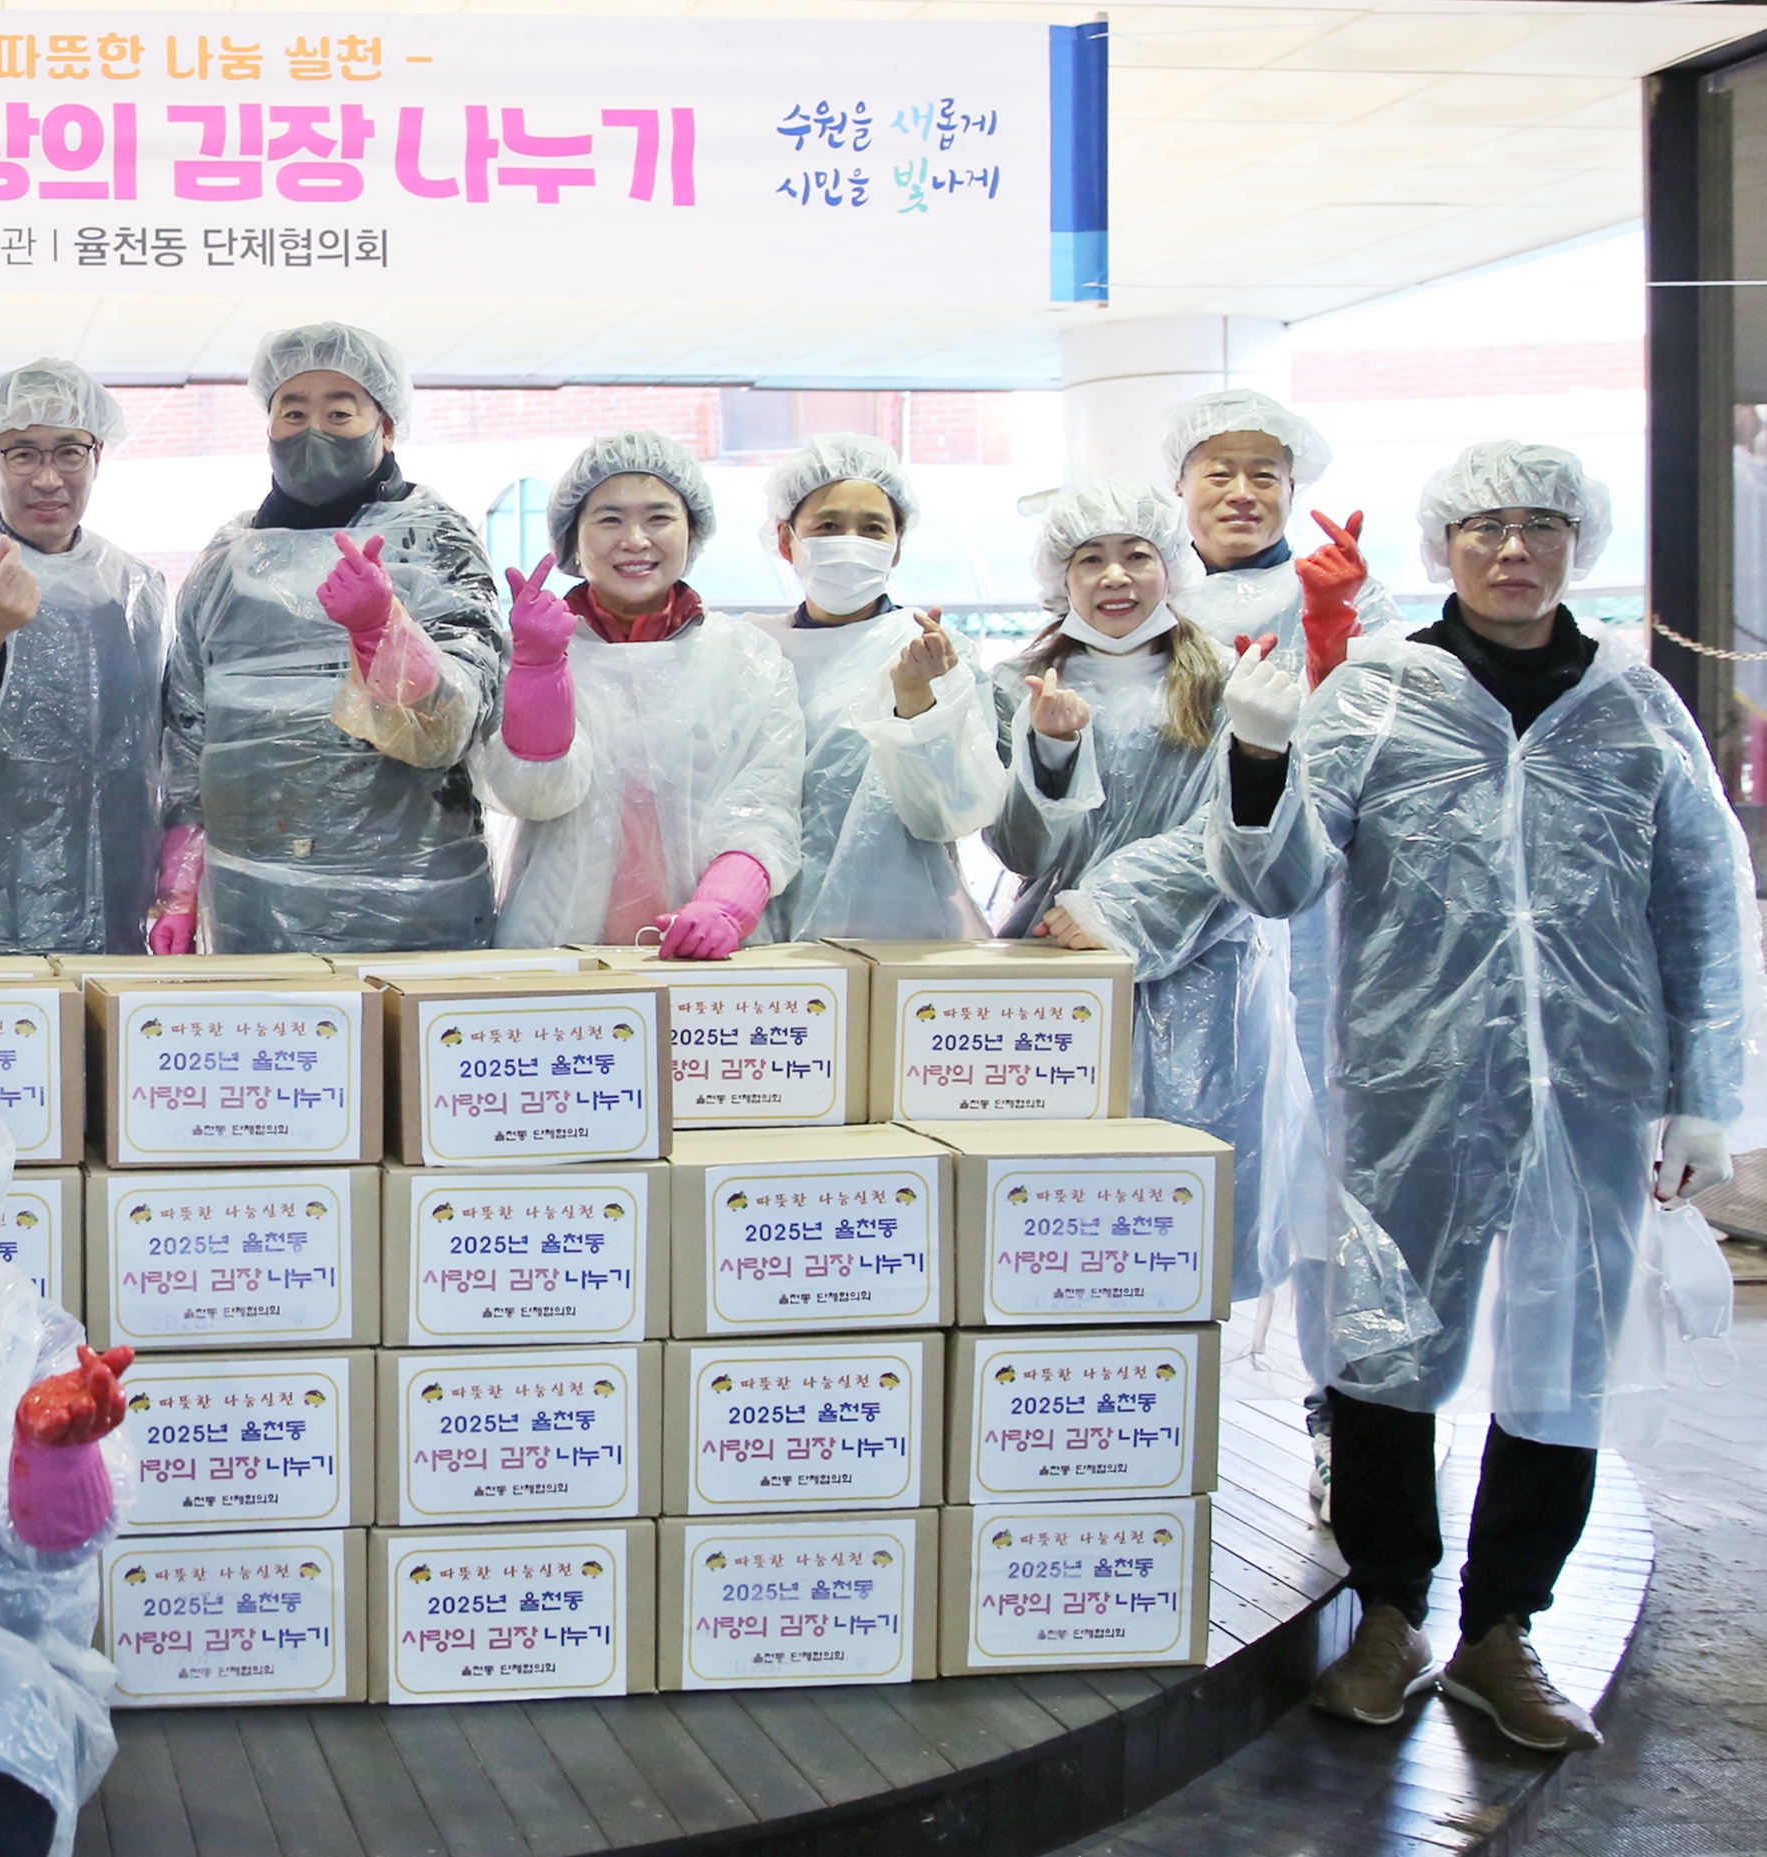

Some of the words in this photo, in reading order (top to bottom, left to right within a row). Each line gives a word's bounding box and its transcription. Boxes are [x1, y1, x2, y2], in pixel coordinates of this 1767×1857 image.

[166, 35, 264, 81] 나눔
[285, 35, 382, 82] 실천
[776, 100, 874, 152] 수원을
[888, 97, 998, 151] 새롭게
[166, 103, 376, 203] 김장
[394, 105, 696, 207] 나누기
[775, 167, 871, 208] 시민을
[891, 156, 1000, 215] 빛나게
[73, 226, 187, 268] 율천동
[203, 227, 388, 268] 단체협의회
[943, 1007, 990, 1020] 따뜻한
[470, 1029, 522, 1044] 따뜻한
[670, 1028, 739, 1046] 2025년
[750, 1026, 808, 1046] 율천동
[932, 1034, 1003, 1052] 2025년
[1015, 1032, 1073, 1052] 율천동
[159, 1052, 239, 1072] 2025년
[252, 1050, 318, 1072] 율천동
[460, 1057, 539, 1078] 2025년
[551, 1054, 615, 1076] 율천동
[721, 1059, 767, 1081] 김장
[771, 1060, 831, 1079] 나누기
[907, 1064, 973, 1086] 사랑의
[986, 1065, 1031, 1086] 김장
[1036, 1066, 1095, 1085] 나누기
[131, 1086, 207, 1110] 사랑의
[221, 1086, 272, 1110] 김장
[277, 1087, 344, 1109] 나누기
[434, 1092, 507, 1117] 사랑의
[521, 1090, 571, 1114] 김장
[576, 1089, 642, 1111] 나누기
[462, 1206, 513, 1221] 따뜻한
[745, 1221, 823, 1242] 2025년
[835, 1218, 898, 1240] 율천동
[1024, 1218, 1100, 1237] 2025년
[1112, 1216, 1173, 1237] 율천동
[450, 1235, 529, 1255] 2025년
[541, 1233, 605, 1254] 율천동
[719, 1256, 792, 1281] 사랑의
[805, 1254, 854, 1278] 김장
[859, 1253, 924, 1275] 나누기
[997, 1251, 1068, 1274] 사랑의
[1081, 1250, 1129, 1273] 김장
[1134, 1251, 1197, 1272] 나누기
[423, 1269, 496, 1293] 사랑의
[510, 1268, 560, 1292] 김장
[565, 1269, 631, 1290] 나누기
[740, 1376, 791, 1391] 따뜻한
[1023, 1367, 1072, 1382] 따뜻한
[451, 1385, 503, 1400] 따뜻한
[1011, 1395, 1085, 1415] 2025년
[1097, 1393, 1157, 1413] 율천동
[440, 1413, 519, 1434] 2025년
[532, 1410, 596, 1432] 율천동
[729, 1405, 806, 1424] 2025년
[818, 1402, 881, 1423] 율천동
[702, 1439, 774, 1463] 사랑의
[787, 1437, 836, 1460] 김장
[841, 1437, 906, 1458] 나누기
[985, 1429, 1054, 1452] 사랑의
[1067, 1427, 1114, 1450] 김장
[1118, 1427, 1180, 1448] 나누기
[414, 1448, 487, 1473] 사랑의
[501, 1446, 551, 1469] 김장
[556, 1445, 622, 1467] 나누기
[439, 1566, 491, 1581] 따뜻한
[1008, 1560, 1082, 1579] 2025년
[1094, 1557, 1154, 1578] 율천동
[722, 1582, 799, 1602] 2025년
[811, 1579, 873, 1600] 율천동
[144, 1596, 224, 1617] 2025년
[237, 1592, 302, 1614] 율천동
[428, 1594, 507, 1615] 2025년
[520, 1591, 584, 1612] 율천동
[982, 1593, 1051, 1616] 사랑의
[1064, 1592, 1111, 1615] 김장
[1116, 1592, 1177, 1613] 나누기
[401, 1628, 475, 1653] 사랑의
[489, 1626, 539, 1650] 김장
[544, 1625, 610, 1647] 나누기
[696, 1616, 767, 1640] 사랑의
[781, 1614, 829, 1637] 김장
[834, 1614, 898, 1635] 나누기
[117, 1630, 192, 1655] 사랑의
[206, 1628, 257, 1652] 김장
[262, 1627, 329, 1649] 나누기
